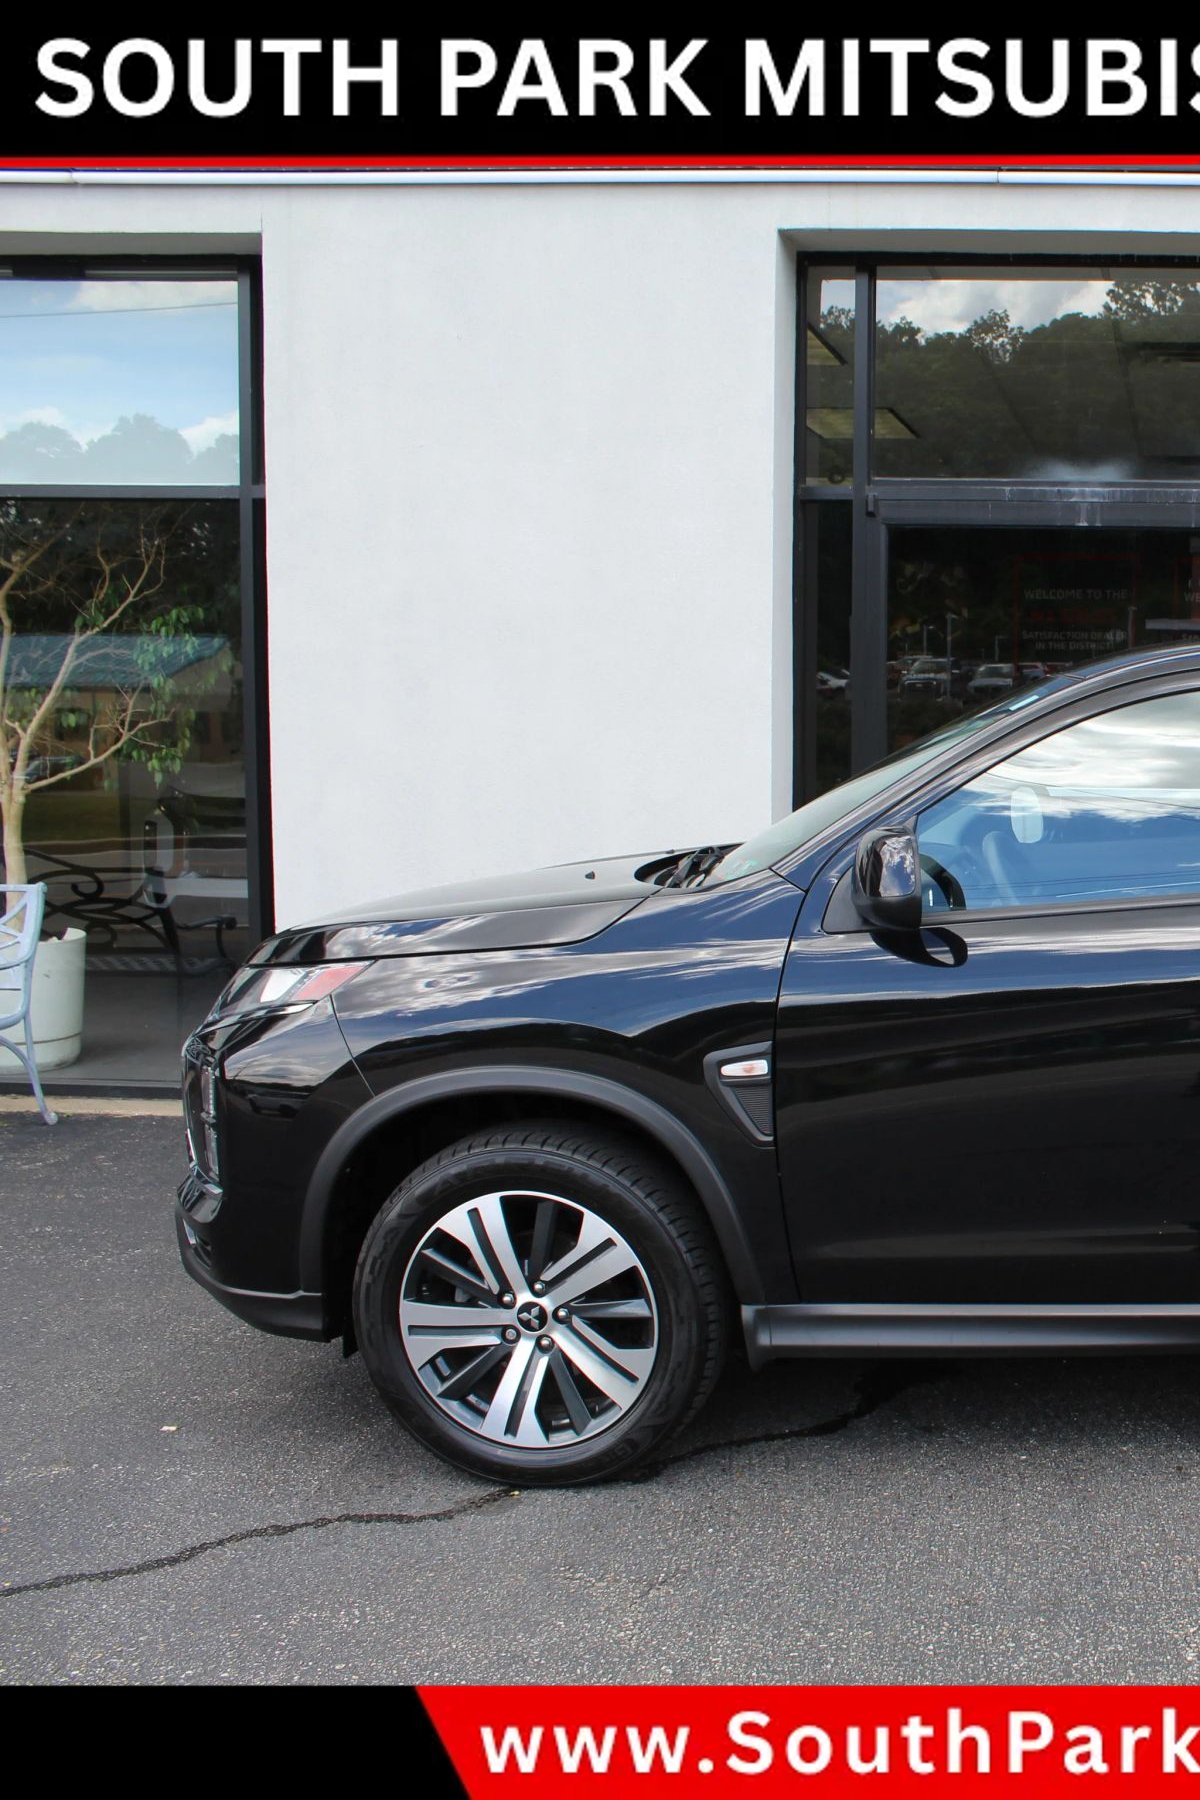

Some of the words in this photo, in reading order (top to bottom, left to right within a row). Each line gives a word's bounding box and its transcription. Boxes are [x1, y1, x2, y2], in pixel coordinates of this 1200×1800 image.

[1023, 588, 1083, 600] WELCOME
[1085, 589, 1103, 600] TO
[1104, 589, 1129, 600] THE
